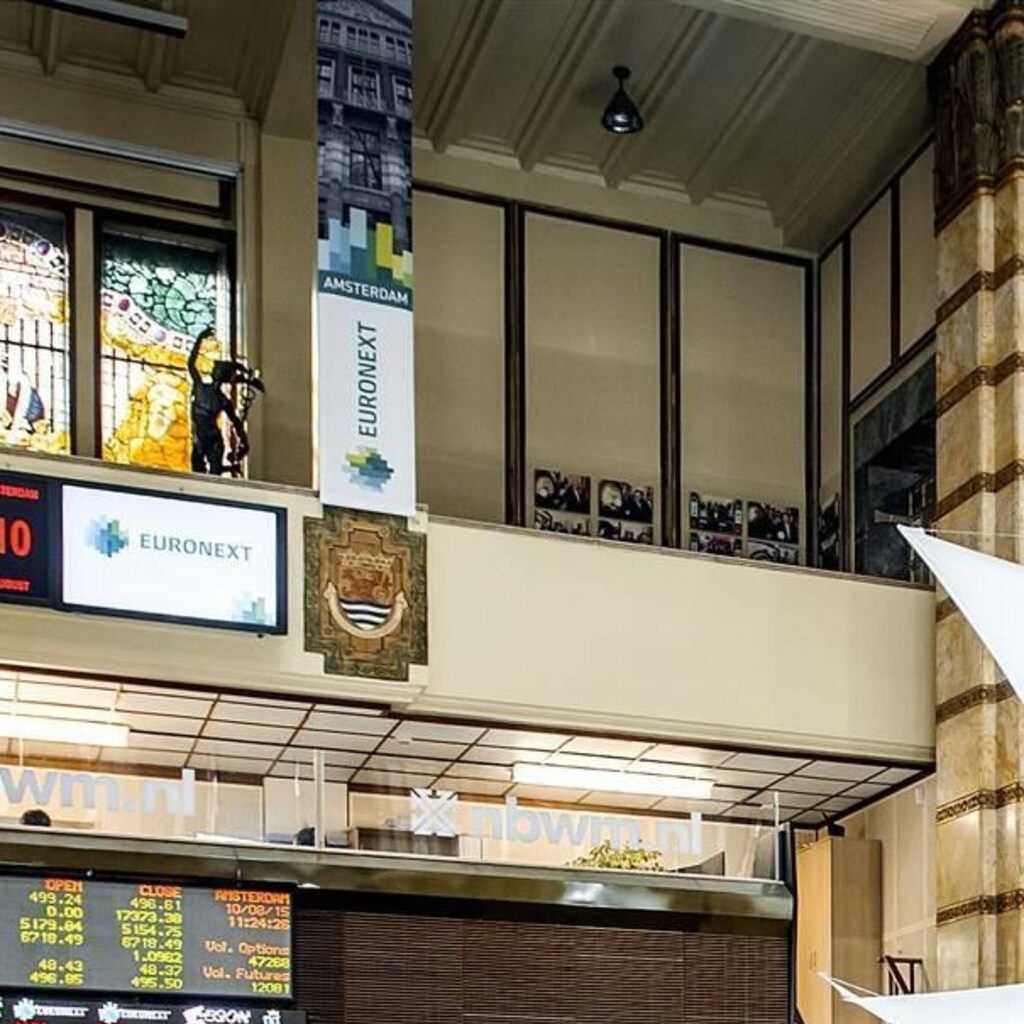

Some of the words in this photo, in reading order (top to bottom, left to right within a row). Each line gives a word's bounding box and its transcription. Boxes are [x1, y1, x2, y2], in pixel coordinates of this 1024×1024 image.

[324, 276, 409, 305] AMSTERDAM
[358, 321, 378, 438] EURONEXT
[139, 533, 253, 561] EURONEXT
[469, 796, 702, 856] nbwm.nl
[44, 880, 83, 893] OPEN
[139, 885, 182, 898] CLOSE
[213, 889, 290, 905] AMSTERDAM
[46, 906, 83, 919] 0.00
[238, 943, 290, 956] Options
[235, 967, 290, 982] Futures
